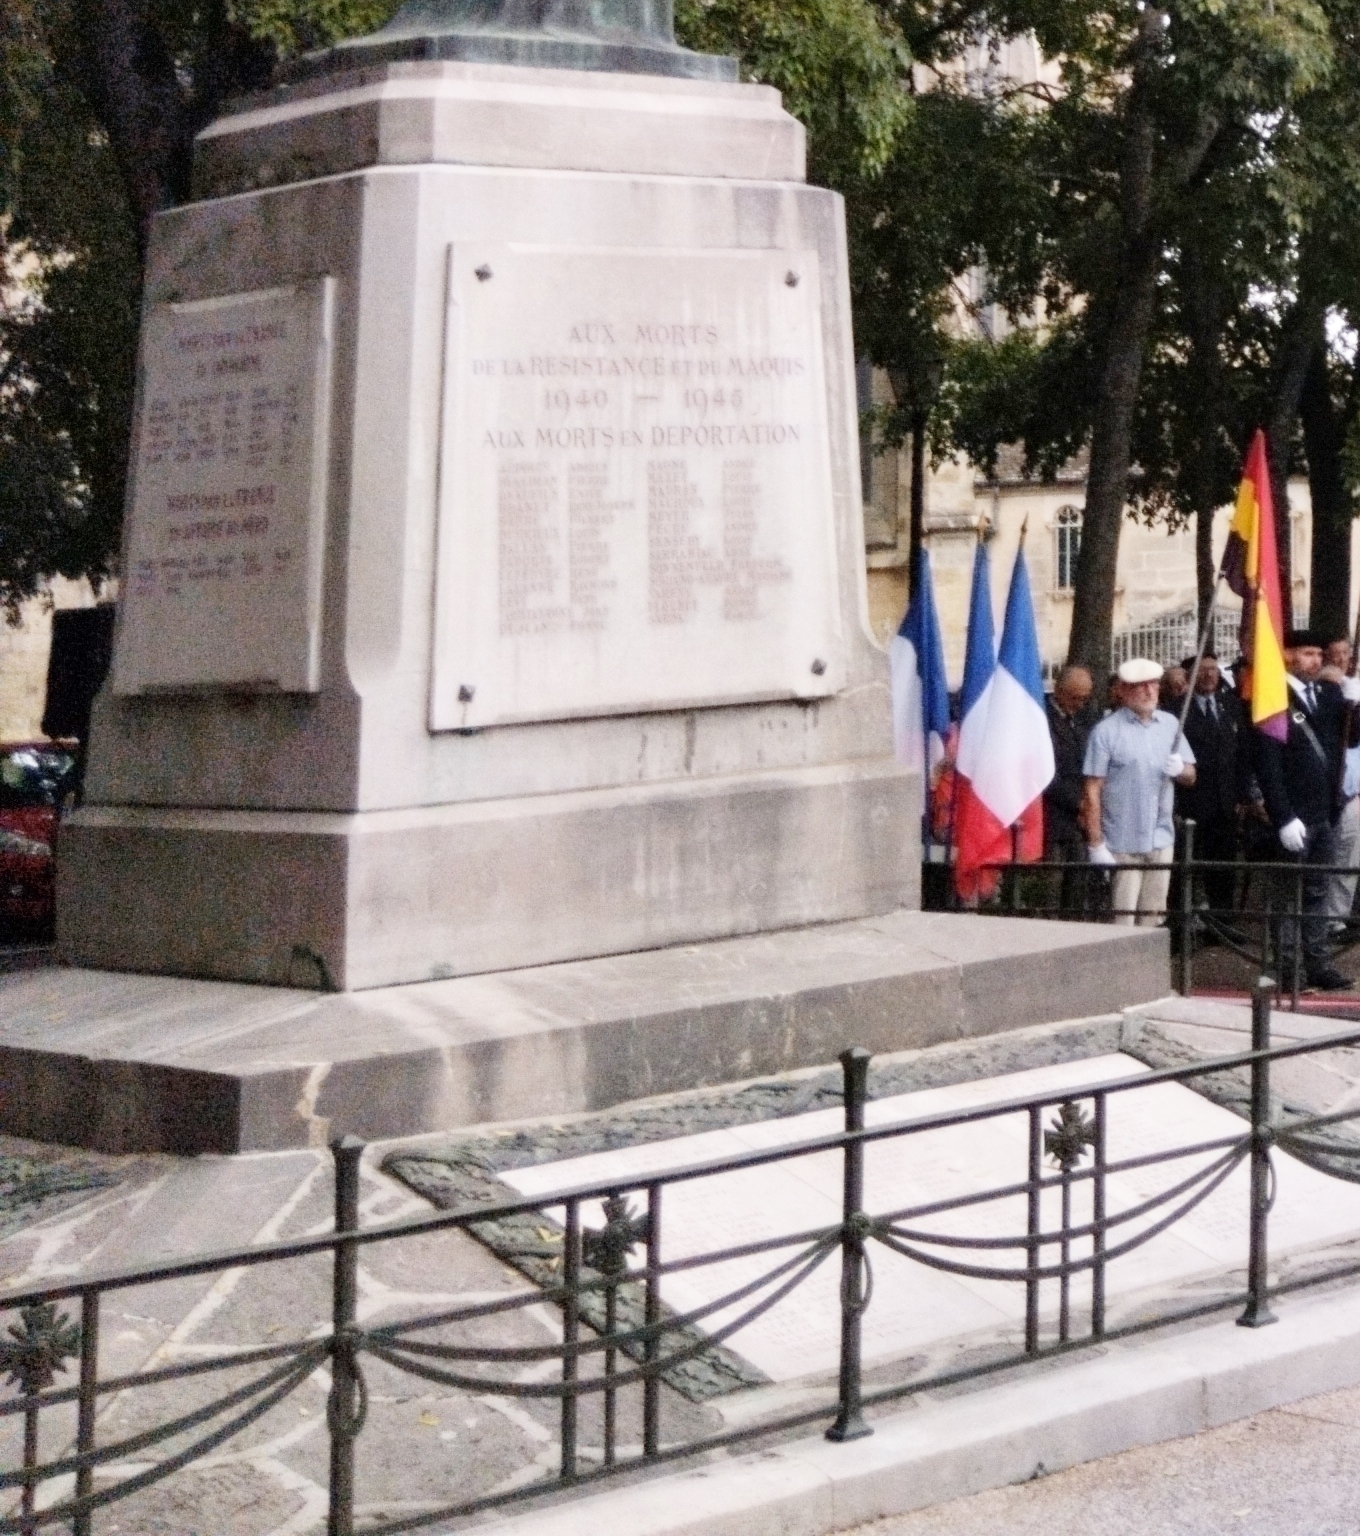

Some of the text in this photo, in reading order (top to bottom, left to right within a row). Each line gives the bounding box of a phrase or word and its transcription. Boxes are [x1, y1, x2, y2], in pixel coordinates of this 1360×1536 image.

[569, 324, 718, 345] AUX MORTS
[473, 359, 496, 376] DE
[503, 359, 524, 376] LA
[531, 356, 665, 378] RESISTANCE
[726, 356, 805, 377] MAQUIS
[543, 388, 609, 415] 1940
[684, 388, 744, 415] 1945
[483, 424, 801, 449] AUX MORTS EN DEPORTATION
